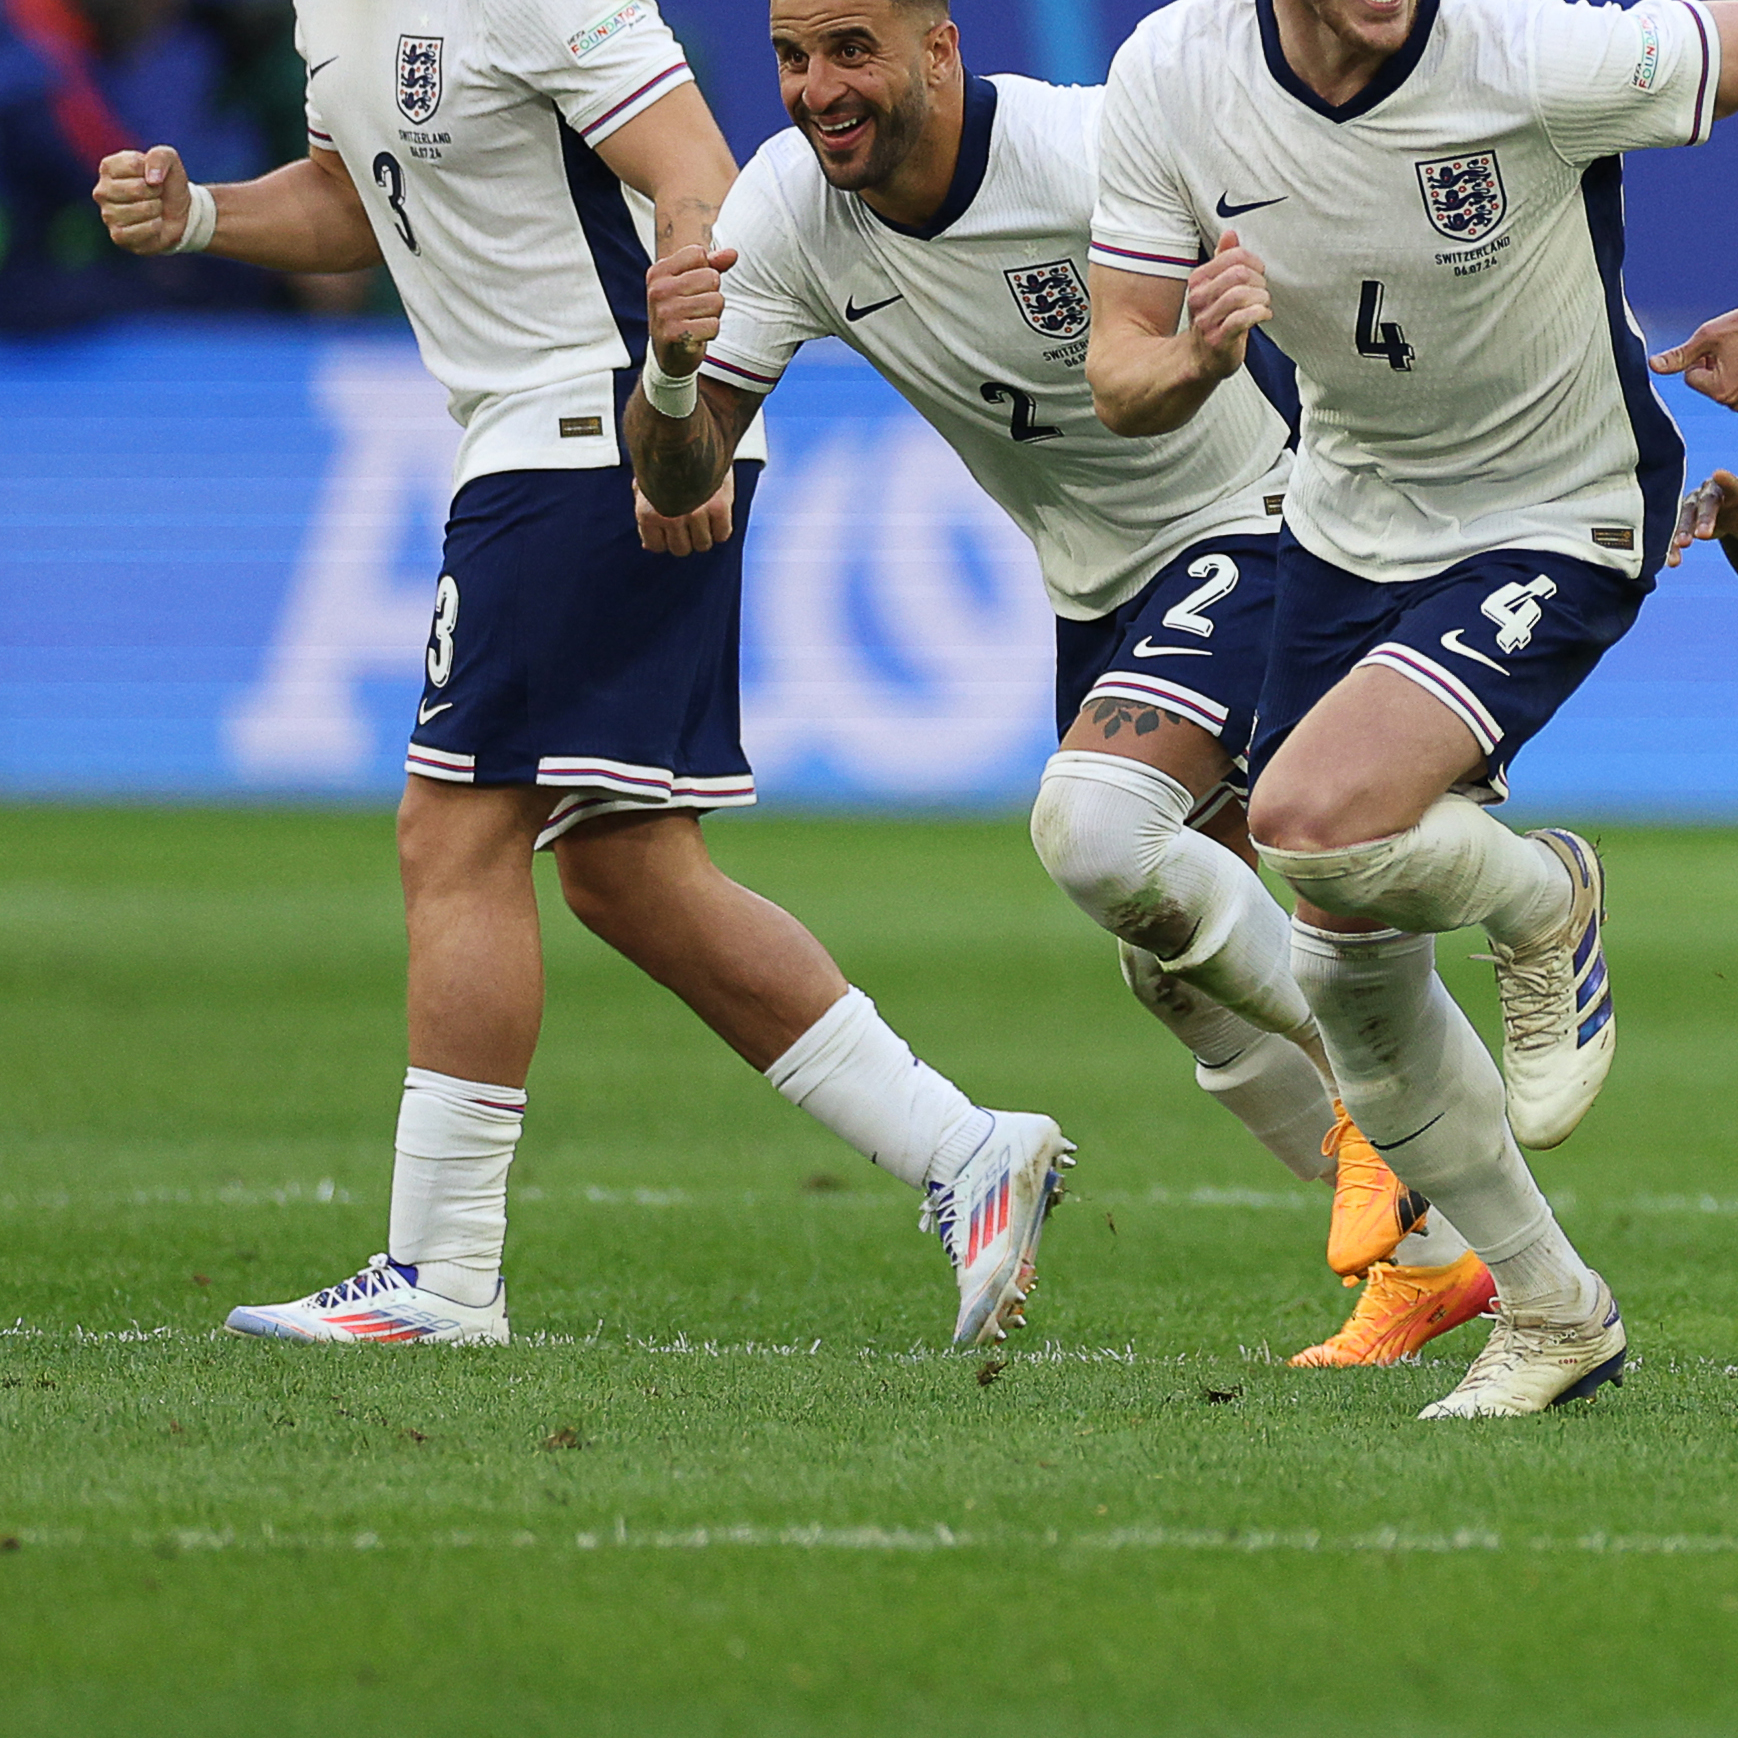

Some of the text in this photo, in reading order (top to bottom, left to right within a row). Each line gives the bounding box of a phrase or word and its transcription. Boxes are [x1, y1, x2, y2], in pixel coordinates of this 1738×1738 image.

[373, 151, 420, 255] 3
[1435, 236, 1510, 265] SWITZERLAND
[1454, 256, 1497, 277] 06.07.24
[1043, 339, 1090, 361] SWITZER
[1064, 352, 1087, 367] 06.0
[1355, 280, 1415, 371] 4
[980, 381, 1064, 444] 2
[426, 575, 461, 688] 3
[1162, 552, 1239, 639] 2
[1482, 573, 1557, 655] 4
